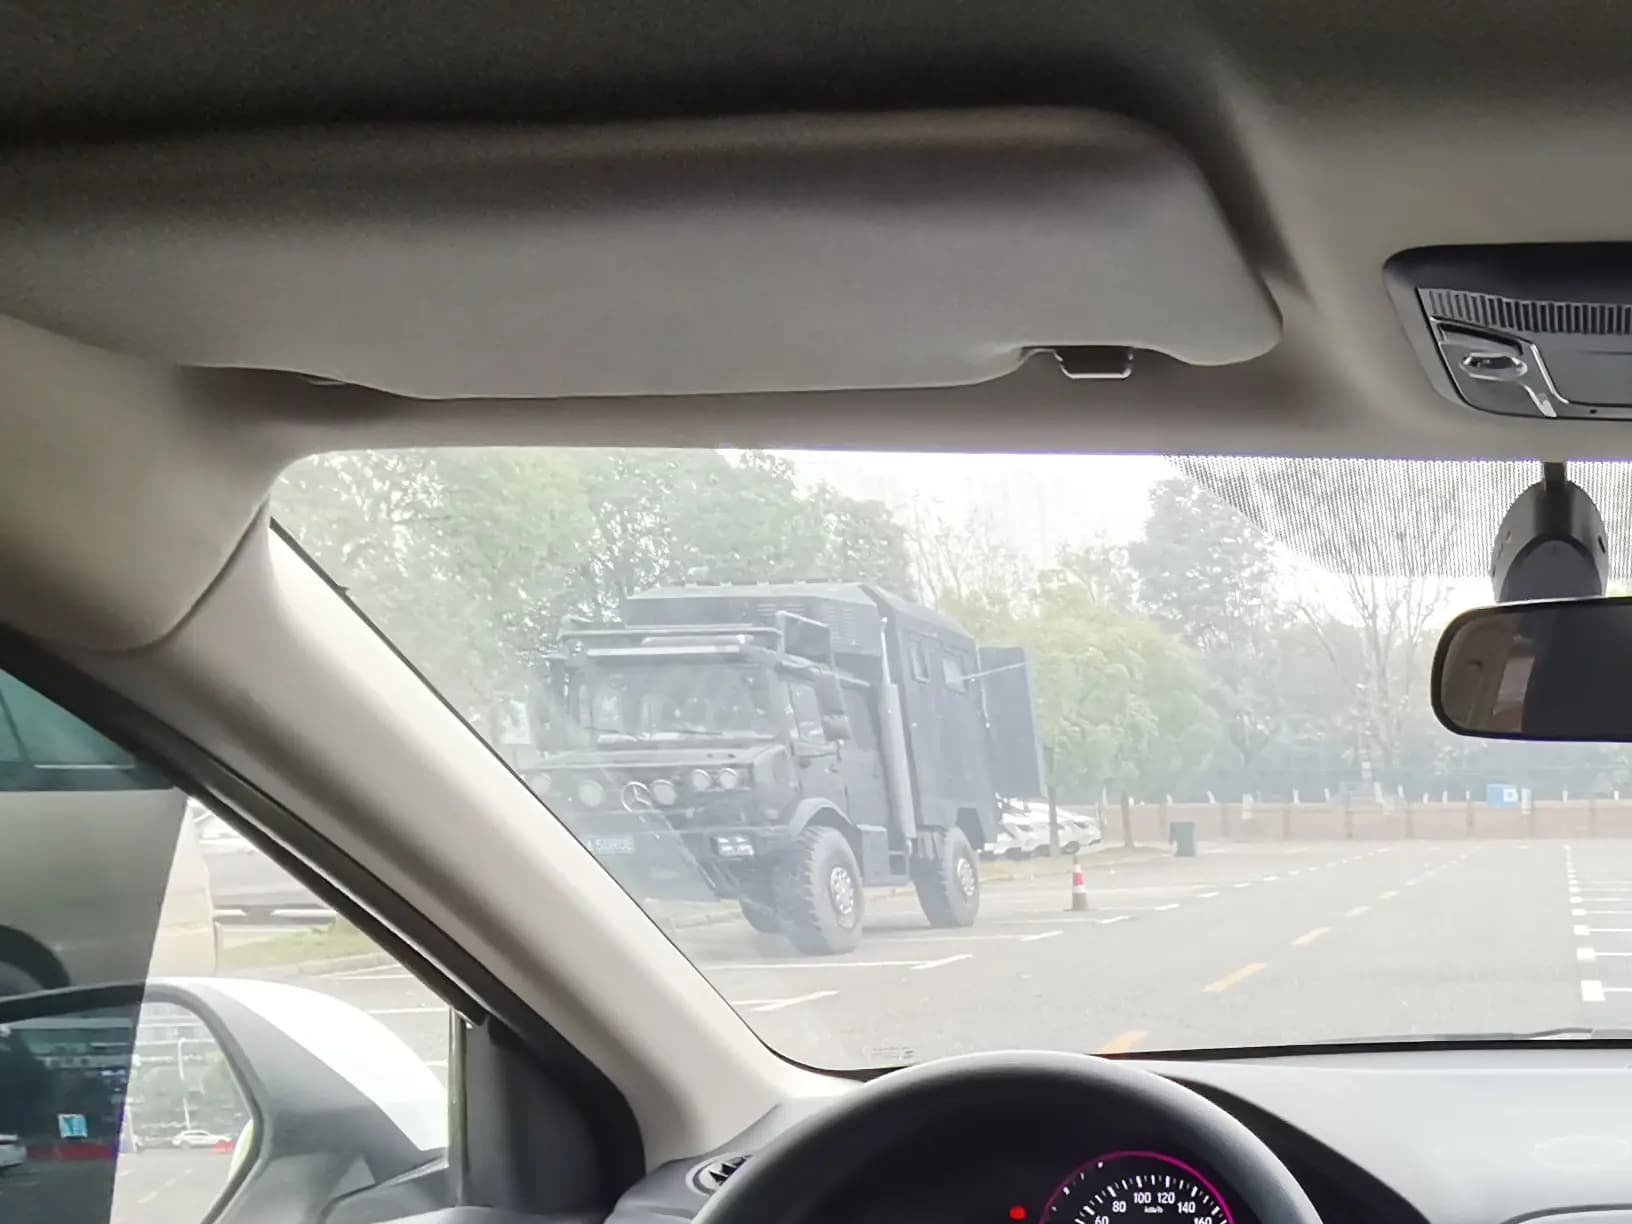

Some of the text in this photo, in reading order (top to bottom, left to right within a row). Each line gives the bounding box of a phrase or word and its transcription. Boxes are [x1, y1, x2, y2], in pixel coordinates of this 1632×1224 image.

[1133, 1192, 1152, 1204] 100
[1157, 1192, 1176, 1204] 120
[1112, 1200, 1127, 1213] 80
[1177, 1201, 1196, 1214] 140
